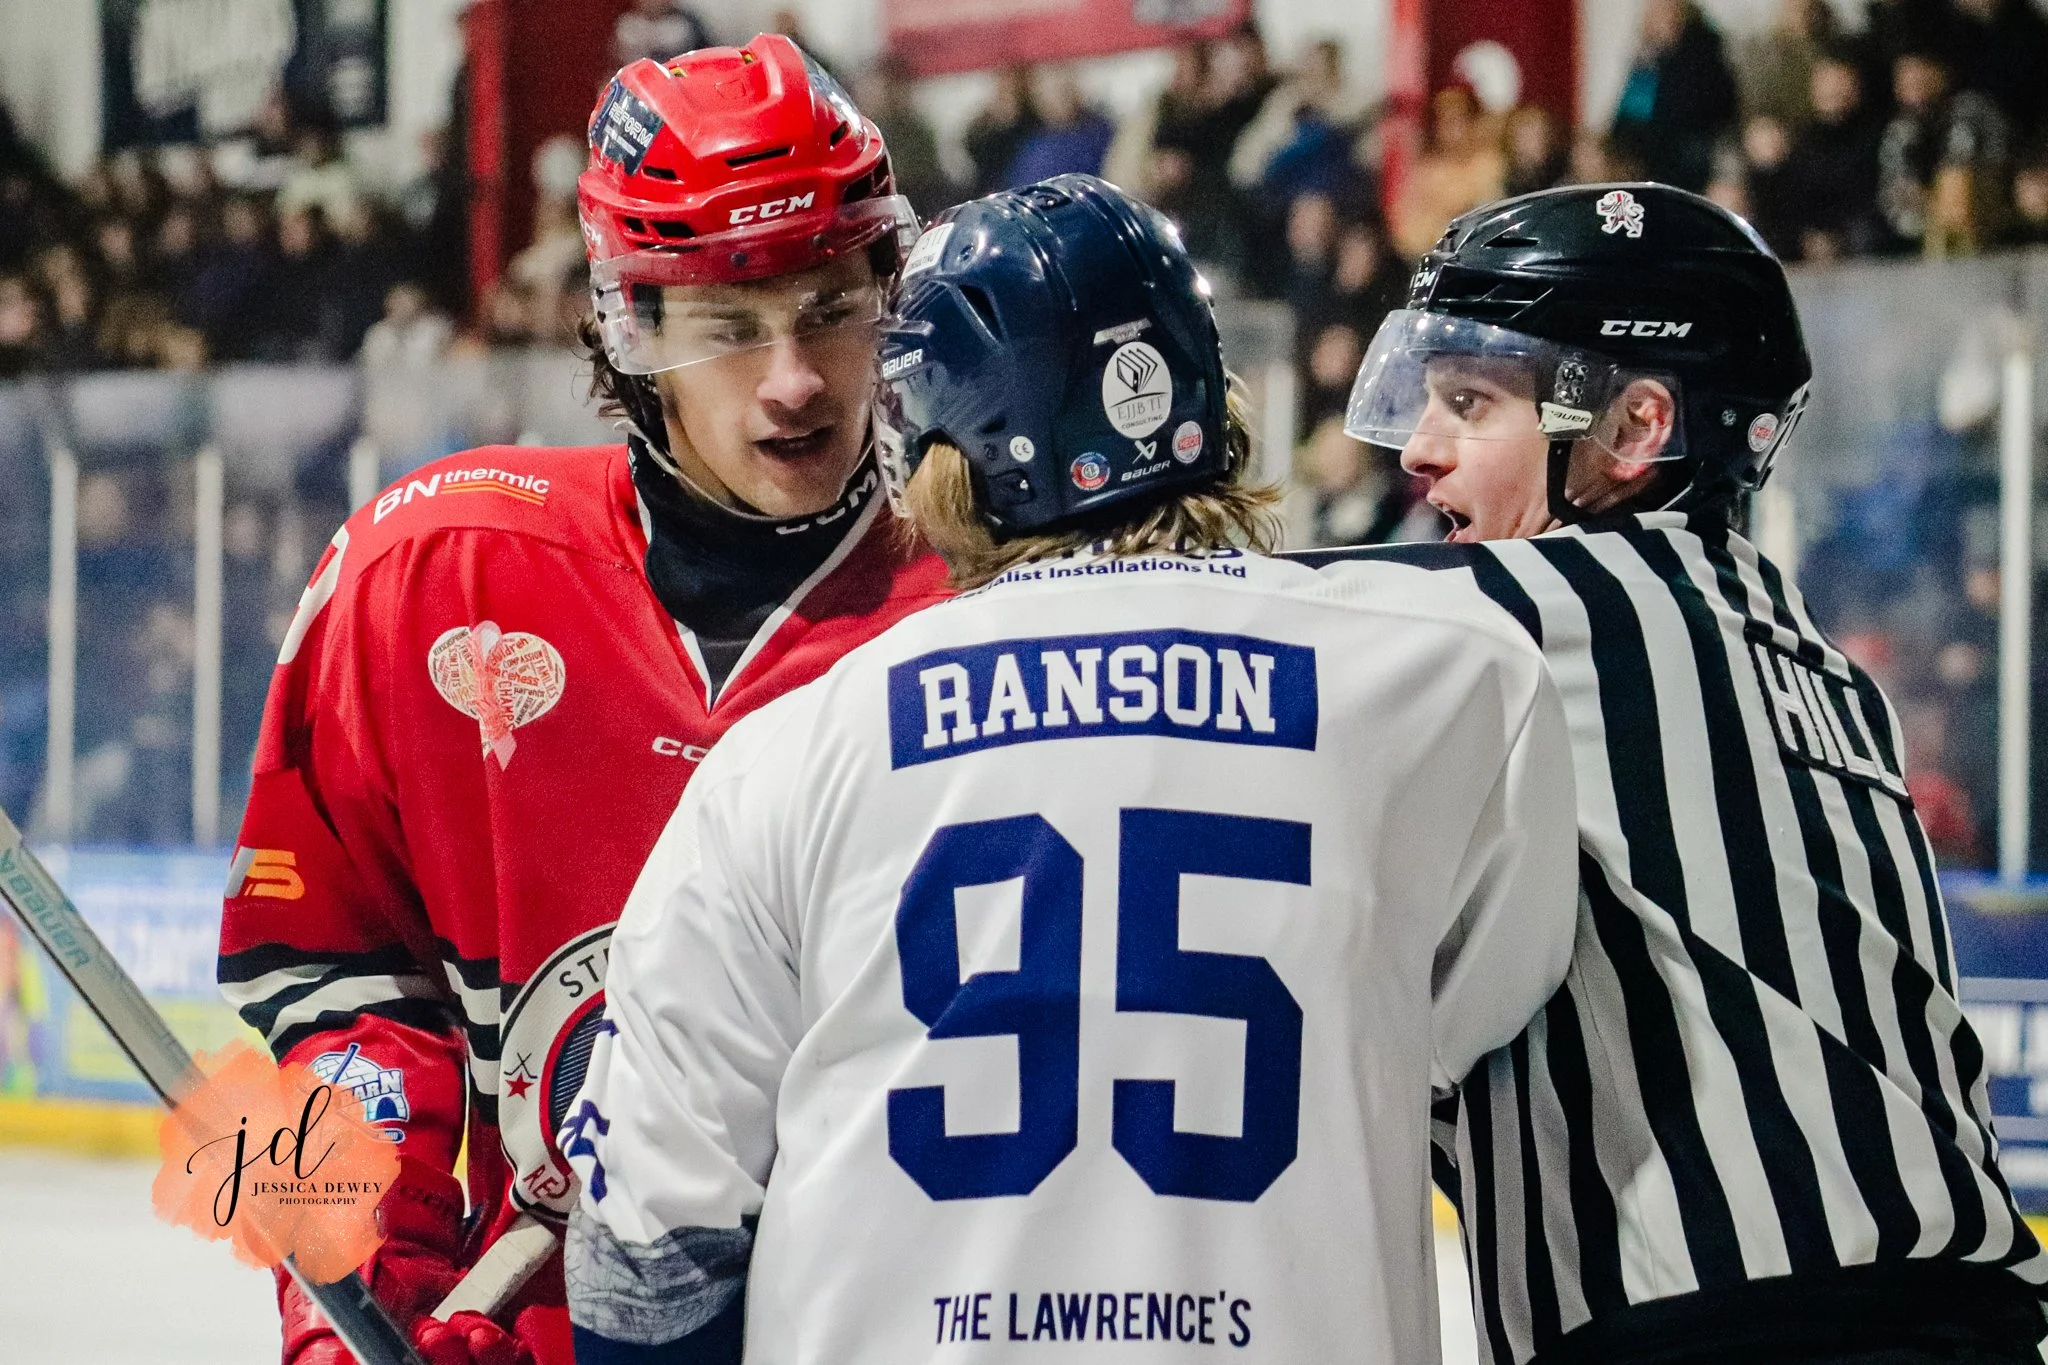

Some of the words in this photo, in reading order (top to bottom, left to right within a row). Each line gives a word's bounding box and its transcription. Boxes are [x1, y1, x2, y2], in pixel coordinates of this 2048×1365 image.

[609, 101, 653, 148] REFORM
[729, 191, 815, 225] CCM
[1410, 271, 1437, 288] CM
[1600, 320, 1693, 338] CCM
[882, 349, 923, 378] BAUER
[1121, 414, 1163, 430] CONSULTING
[1551, 411, 1590, 423] AUER
[1121, 460, 1171, 481] BAUER
[373, 474, 442, 525] BN
[445, 468, 550, 494] thermic
[1050, 557, 1202, 579] Installations
[1208, 563, 1247, 578] Ltd
[919, 643, 1276, 750] RANSON
[1754, 642, 1910, 797] HILL
[652, 736, 709, 763] CC
[8, 873, 92, 969] BAUER
[559, 947, 610, 998] ST
[887, 807, 1312, 1203] 95
[934, 1293, 991, 1344] THE
[1008, 1291, 1252, 1348] LAWRENCE'S
